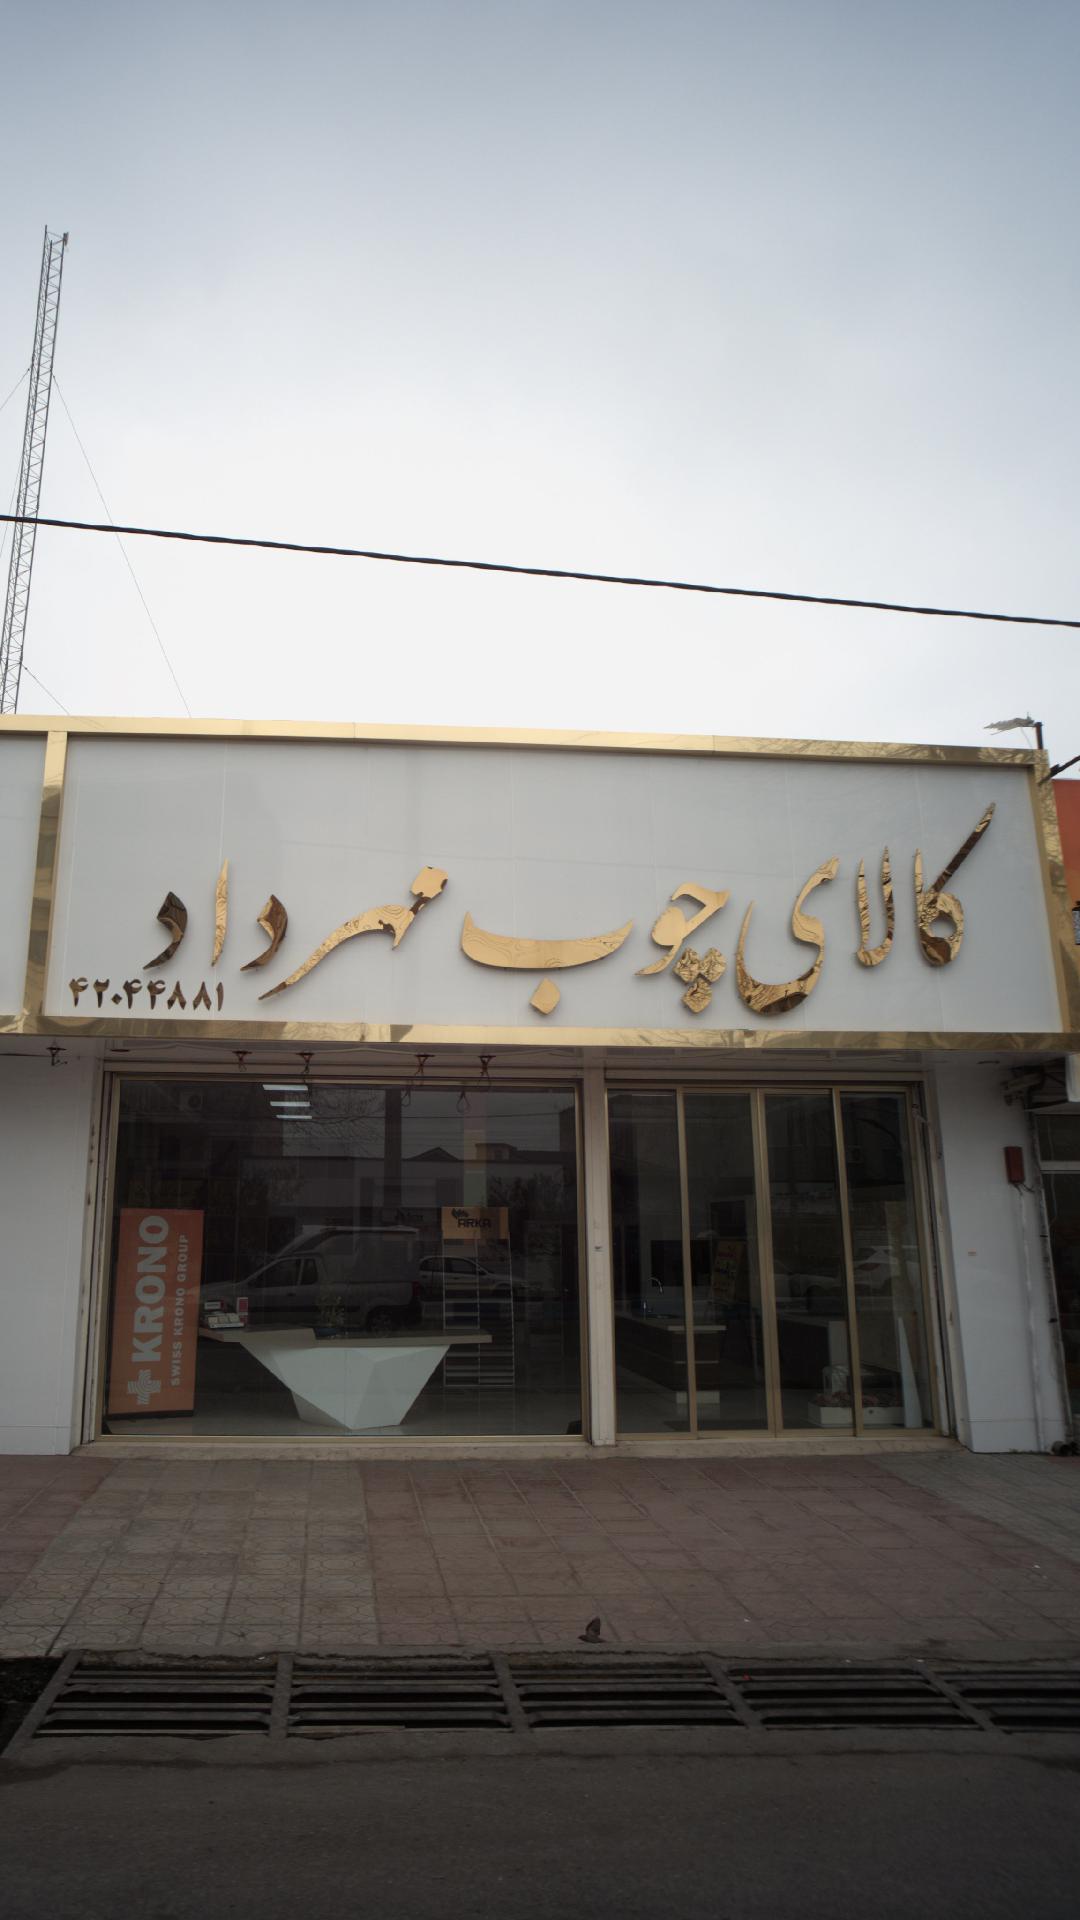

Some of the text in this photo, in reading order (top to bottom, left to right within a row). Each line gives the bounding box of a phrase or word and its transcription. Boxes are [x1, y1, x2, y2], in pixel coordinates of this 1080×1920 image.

[461, 881, 730, 1015] چوب
[735, 802, 995, 1016] کالای
[69, 977, 224, 1012] ۴۲۰۴۴۸۸۱
[131, 1215, 169, 1362] KRONO
[171, 1234, 189, 1386] SWISS KRONO GROUP
